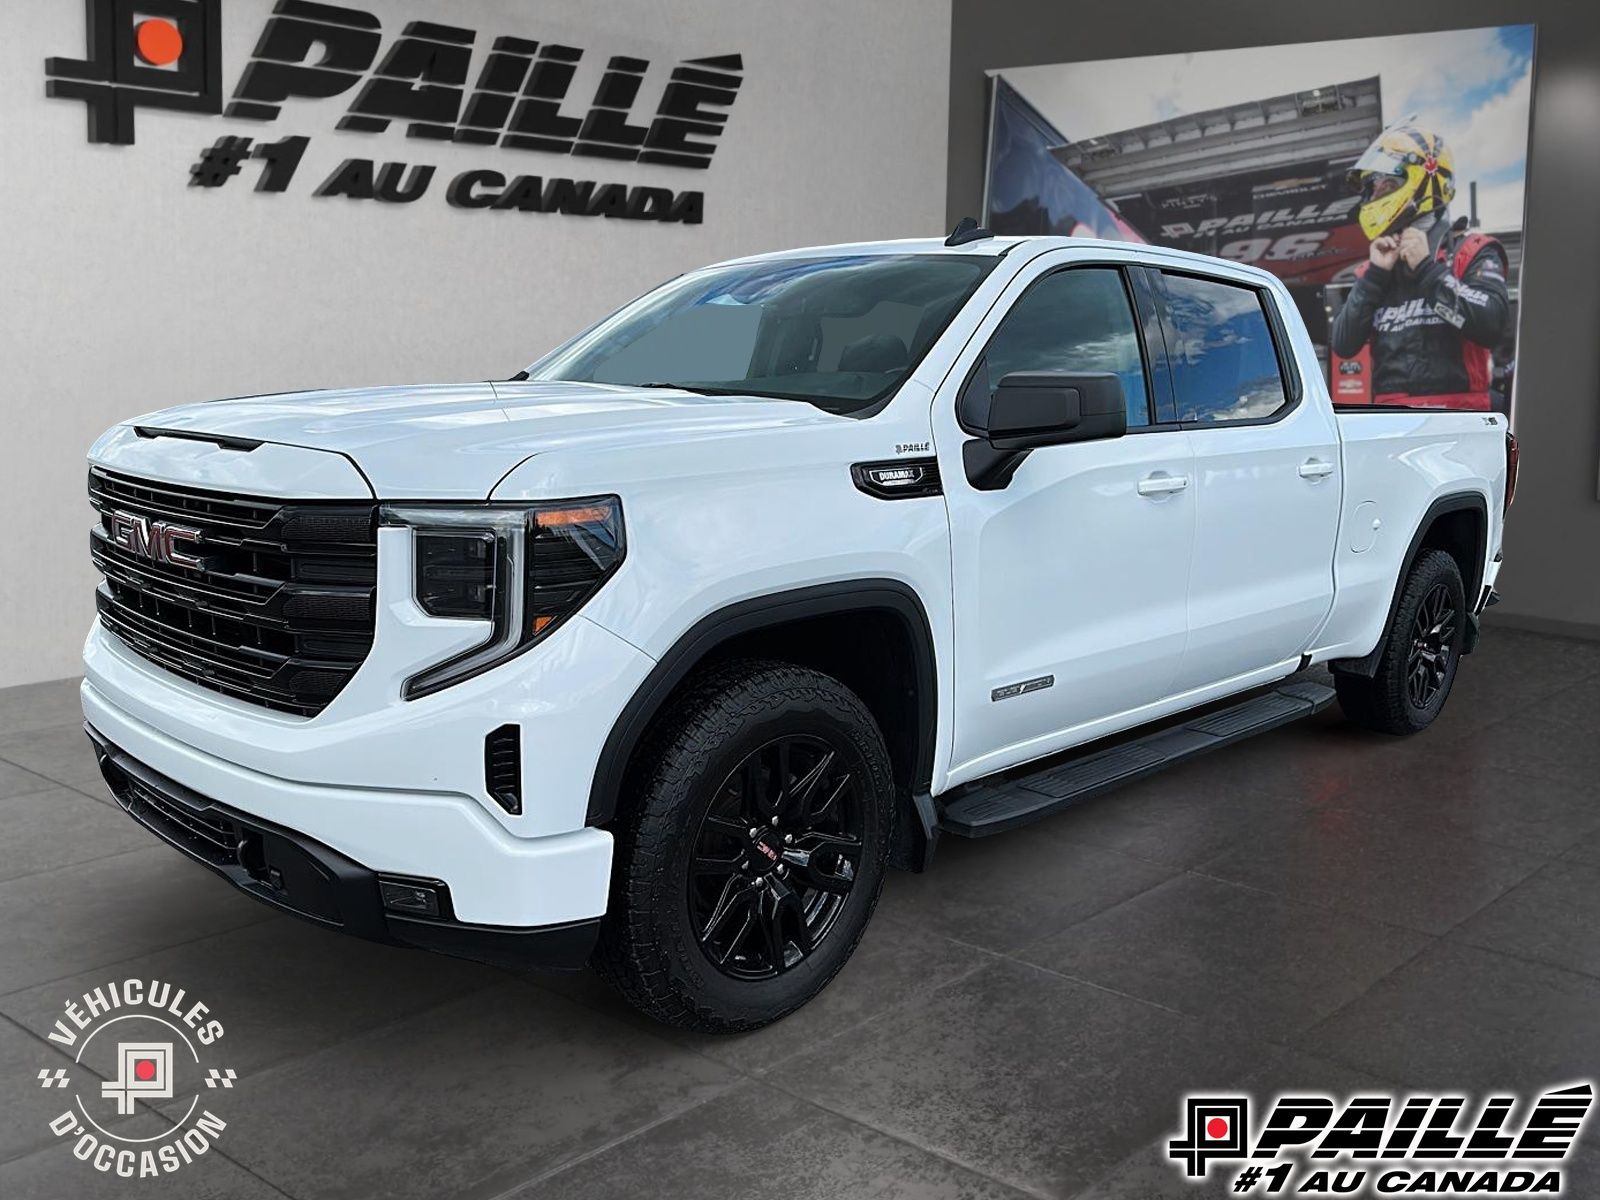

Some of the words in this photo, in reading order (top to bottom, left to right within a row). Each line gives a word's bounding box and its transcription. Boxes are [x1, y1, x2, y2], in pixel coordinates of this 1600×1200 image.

[223, 0, 743, 169] PAILLÉ
[187, 135, 310, 192] #1
[312, 158, 436, 203] AU
[446, 169, 704, 224] CANADA
[1220, 231, 1328, 261] 96
[879, 469, 915, 481] DURAMAX
[111, 509, 206, 572] GMC
